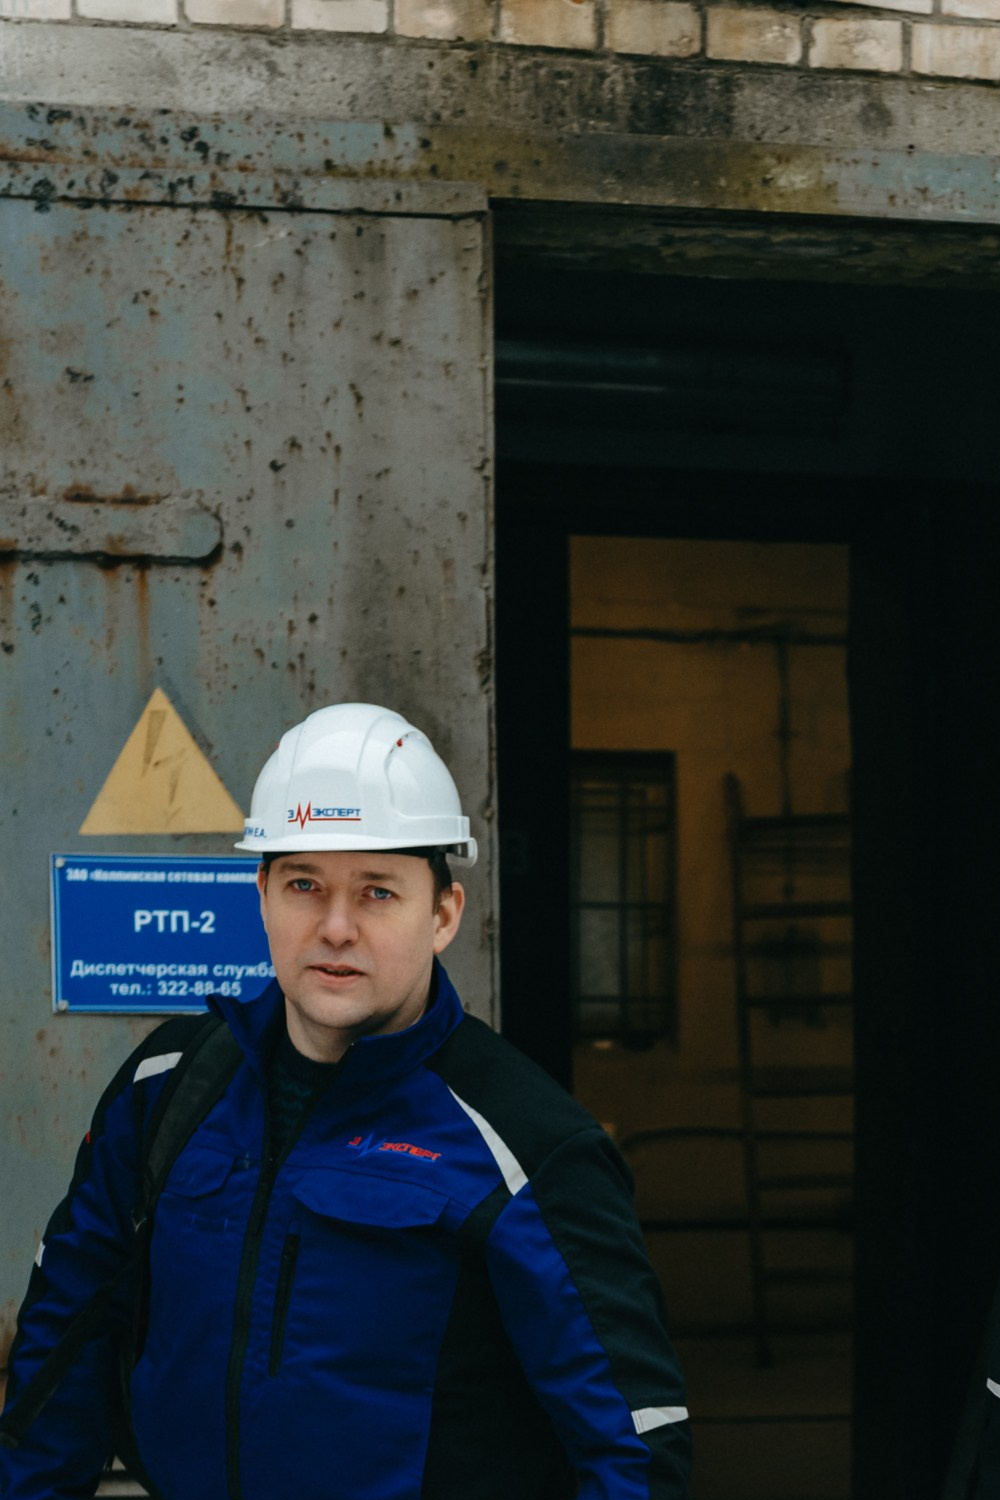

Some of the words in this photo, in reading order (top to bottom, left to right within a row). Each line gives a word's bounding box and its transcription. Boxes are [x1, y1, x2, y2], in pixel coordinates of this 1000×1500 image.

[134, 910, 216, 933] РТП-2
[70, 959, 208, 978] Диспетчерская
[157, 981, 242, 996] 322-88-65
